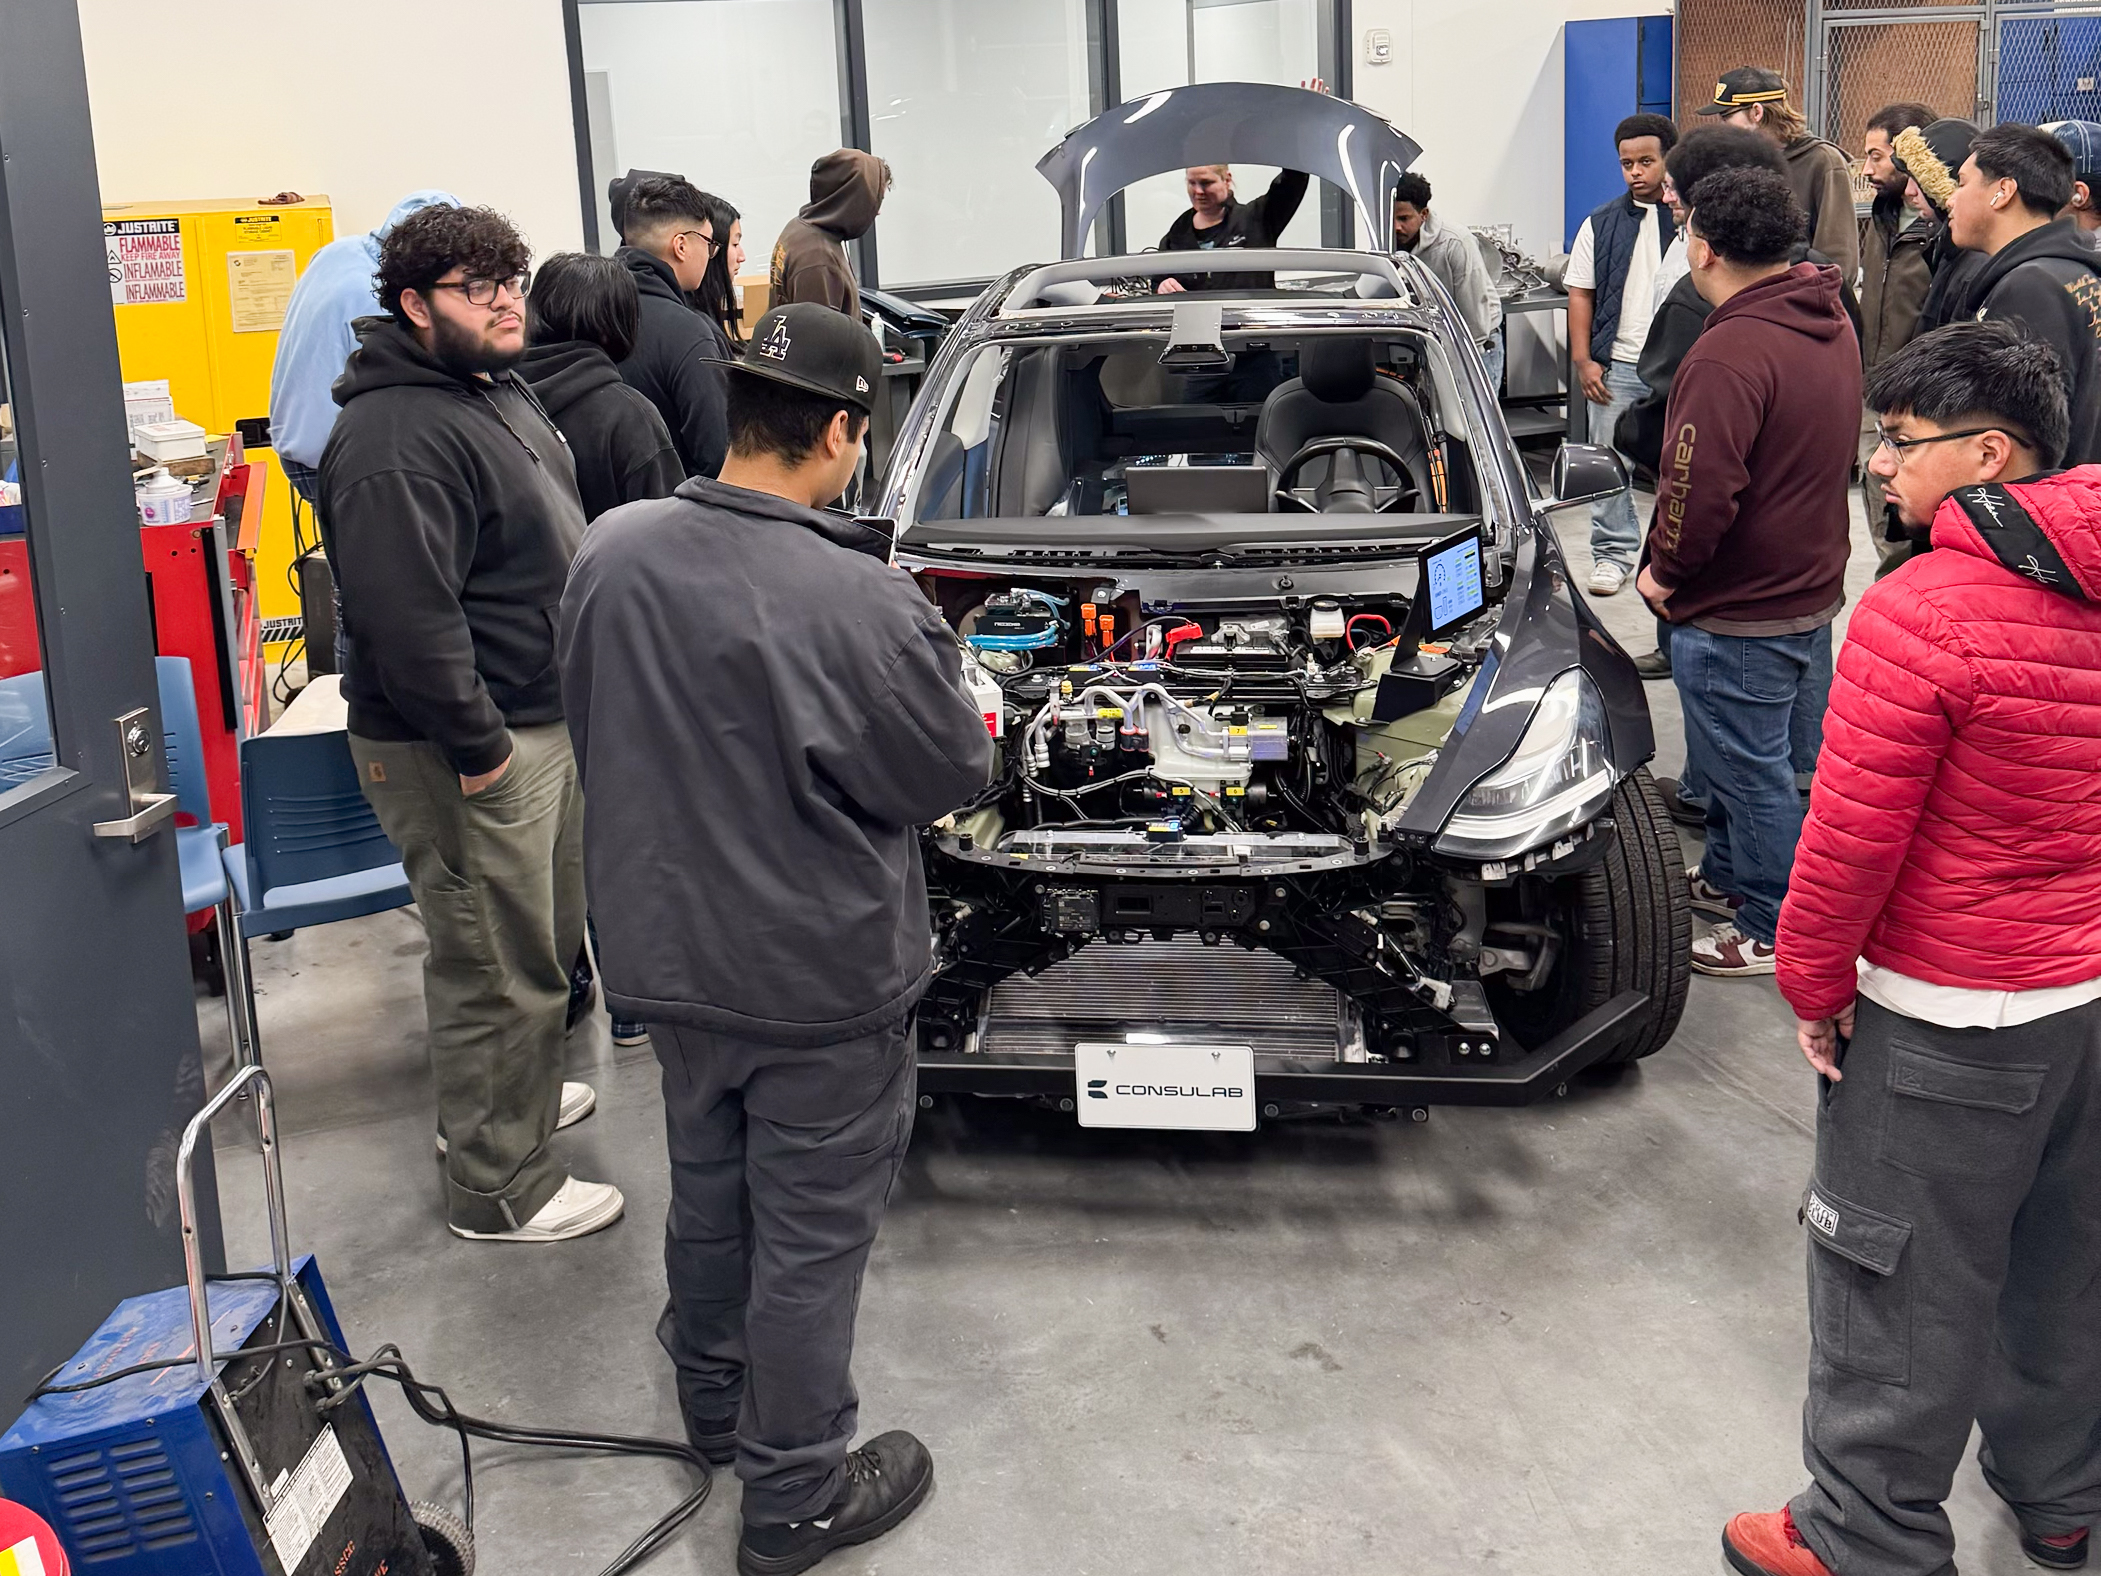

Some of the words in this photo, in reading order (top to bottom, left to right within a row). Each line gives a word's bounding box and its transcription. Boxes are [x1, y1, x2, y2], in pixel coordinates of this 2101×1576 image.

[117, 220, 175, 234] JUSTRITE
[119, 235, 181, 252] FLAMMABLE
[120, 252, 140, 262] KEEP
[141, 252, 157, 261] FIRE
[158, 251, 180, 260] AWAY
[124, 260, 183, 279] INFLAMABLE
[125, 281, 185, 300] INFLAMMABLE
[263, 617, 302, 629] JUSTRIT
[1115, 1085, 1243, 1098] CONSULAB
